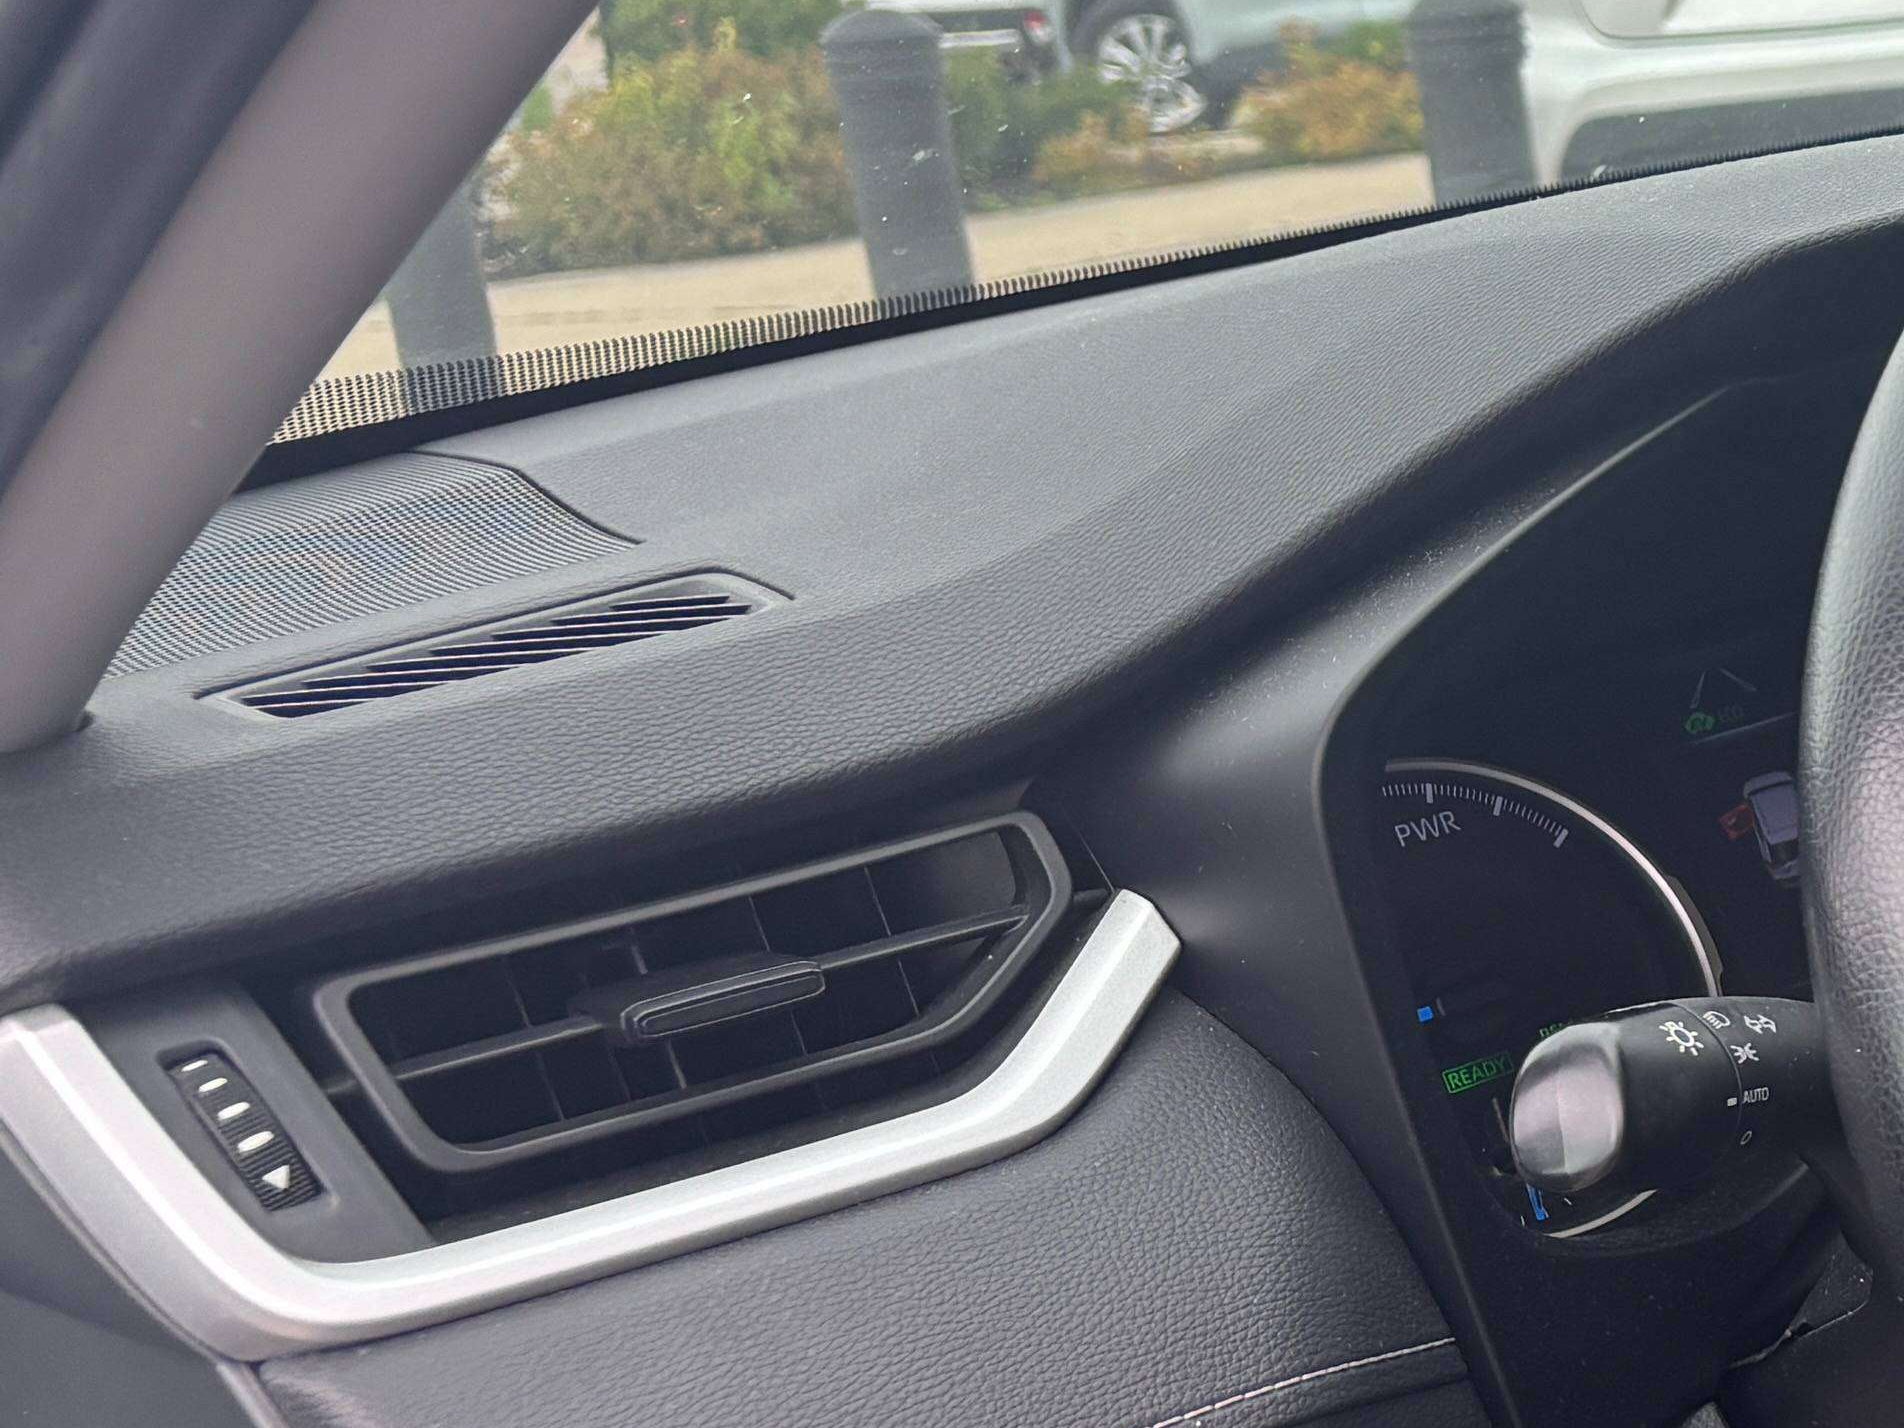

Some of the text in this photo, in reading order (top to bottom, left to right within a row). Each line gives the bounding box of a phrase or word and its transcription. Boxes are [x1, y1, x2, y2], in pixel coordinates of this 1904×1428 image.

[1394, 811, 1461, 847] PWR
[1446, 1056, 1507, 1090] READY
[1742, 1087, 1769, 1104] AUTO
